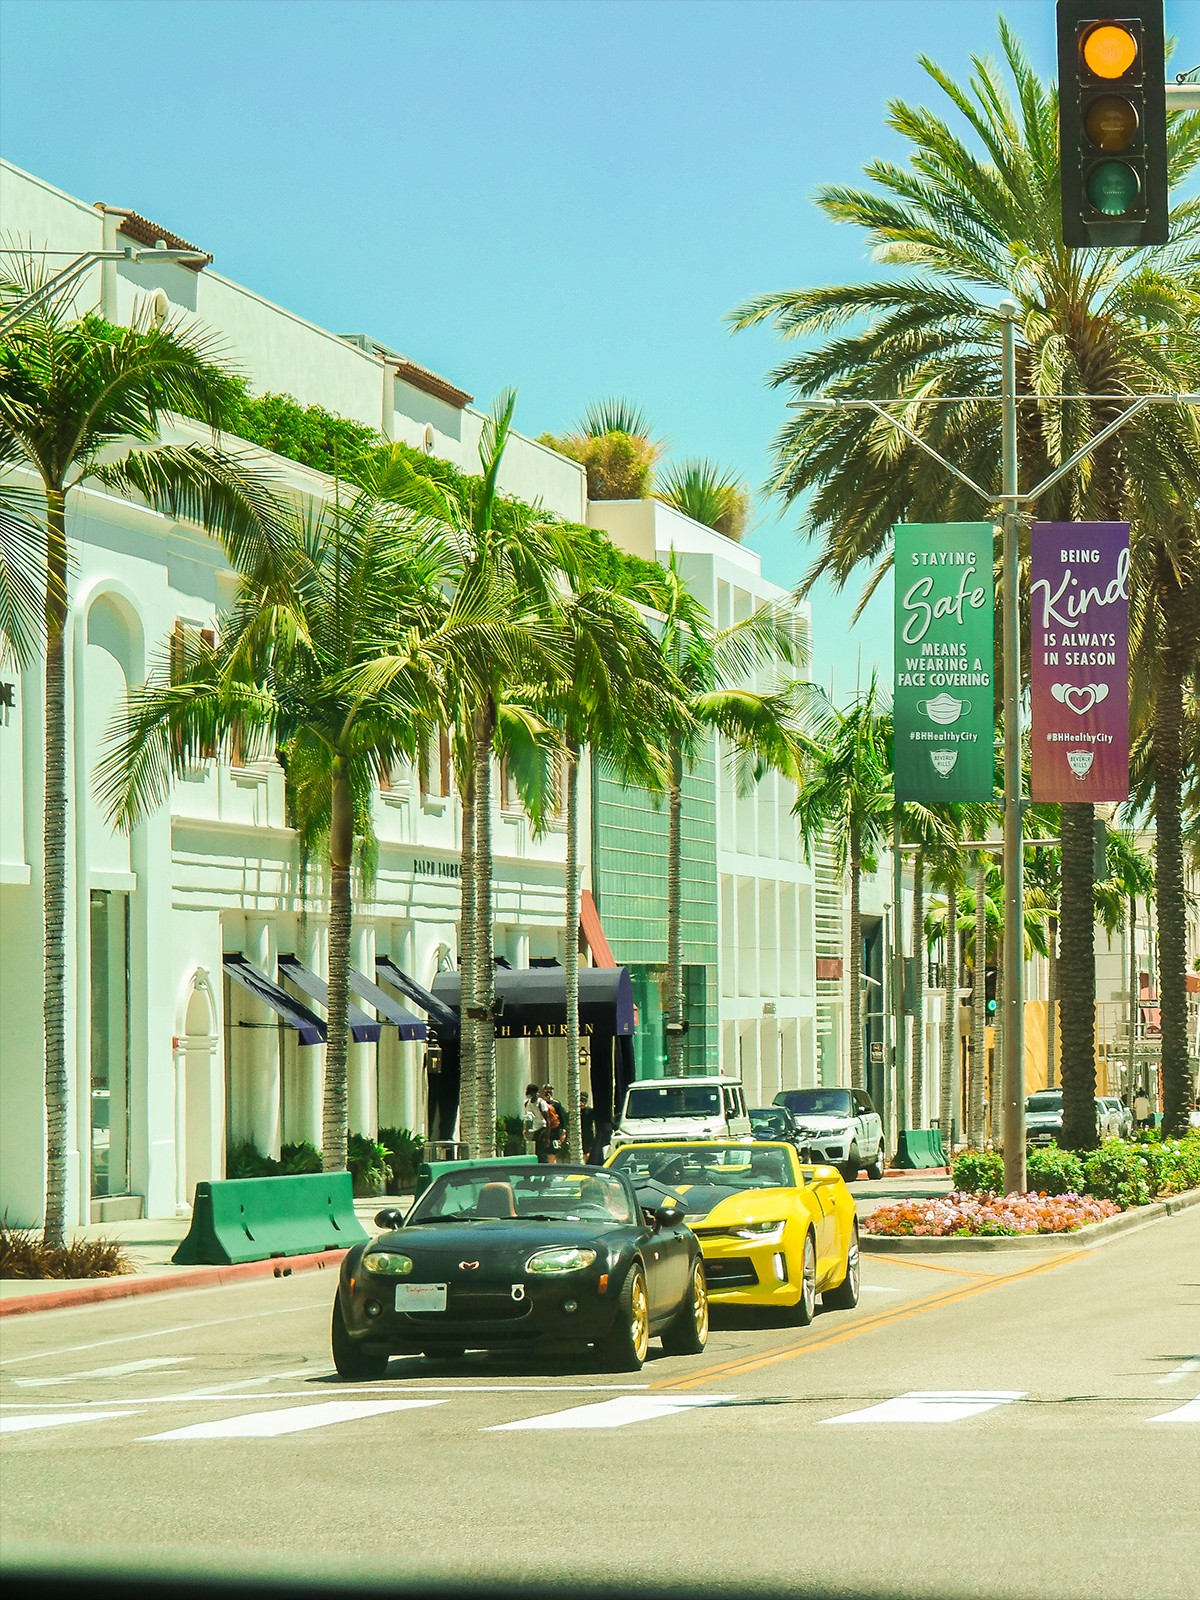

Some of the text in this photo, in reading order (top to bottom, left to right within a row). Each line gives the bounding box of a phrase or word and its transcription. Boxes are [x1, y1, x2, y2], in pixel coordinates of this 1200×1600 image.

[912, 552, 976, 566] STAYING
[1060, 549, 1100, 563] BEING
[1031, 547, 1129, 628] Kind
[902, 566, 986, 644] Safe
[1043, 633, 1116, 646] IS ALWAYS
[921, 643, 967, 656] MEANS
[906, 658, 982, 671] WEARING A
[1043, 652, 1116, 666] IN SEASON
[898, 673, 990, 687] FACE COVERING
[910, 731, 978, 743] #BHHealthyCity
[1046, 732, 1113, 745] #BHHealthyCity
[413, 859, 436, 876] RALPH
[523, 1023, 594, 1036] LAURN
